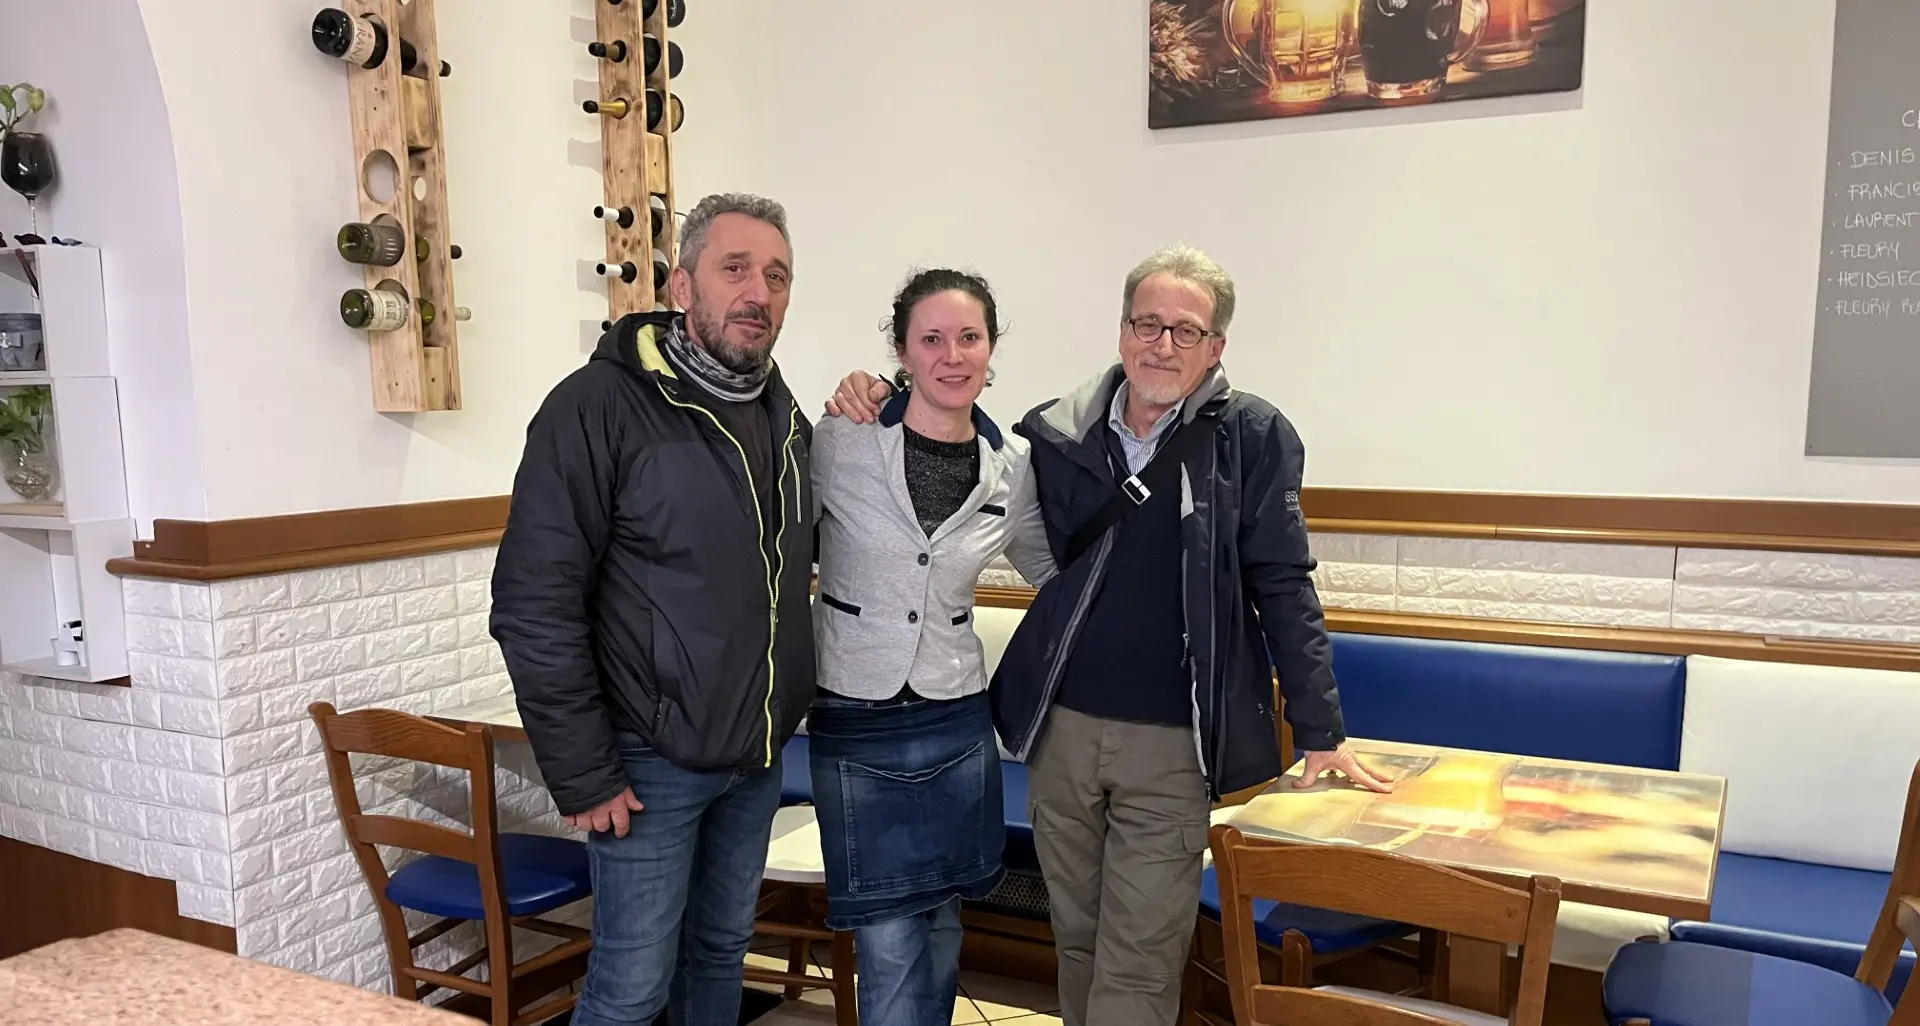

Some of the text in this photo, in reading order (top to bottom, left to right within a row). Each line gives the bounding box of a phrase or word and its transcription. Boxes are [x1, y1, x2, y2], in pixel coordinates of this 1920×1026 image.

[1850, 147, 1915, 168] DENIS
[1844, 211, 1920, 229] LAURENT
[1840, 241, 1899, 262] FLEURY
[1835, 297, 1891, 321] FLEURY
